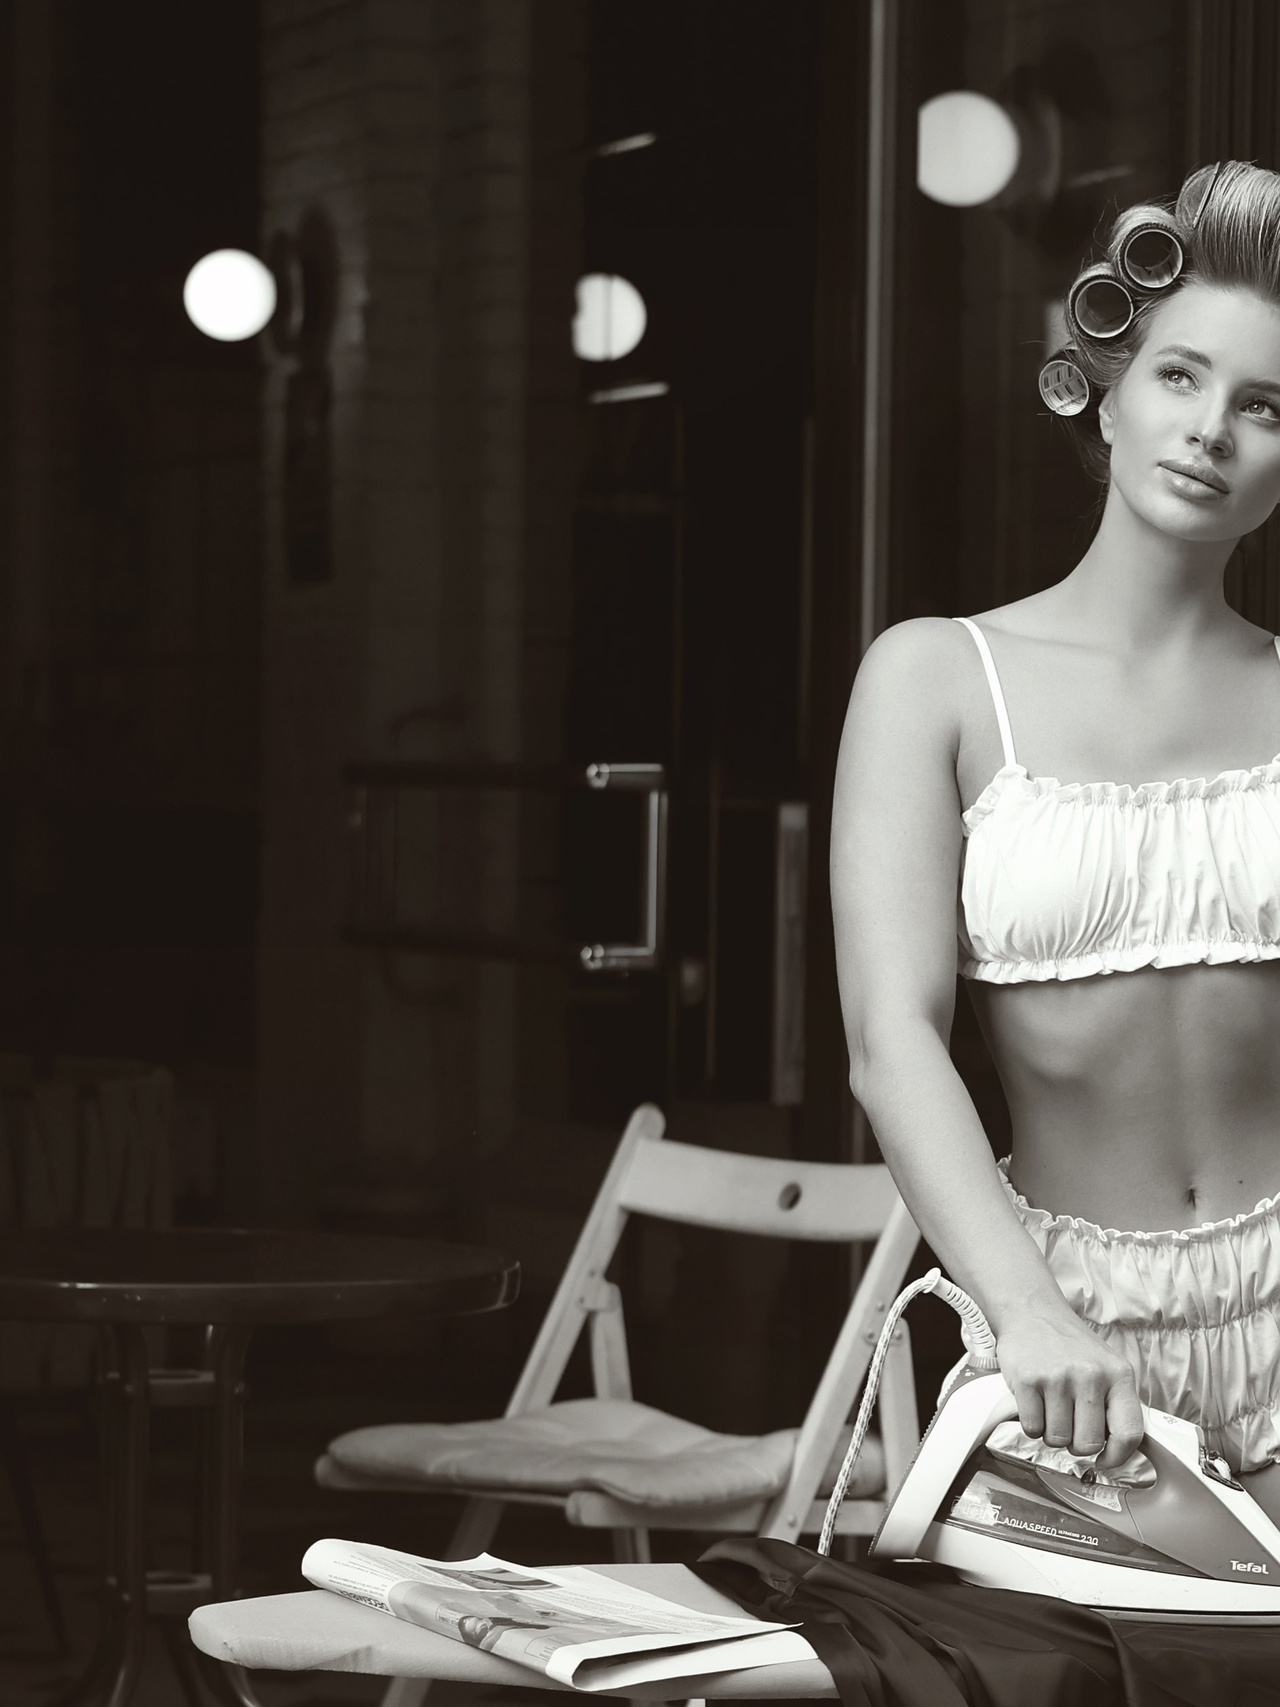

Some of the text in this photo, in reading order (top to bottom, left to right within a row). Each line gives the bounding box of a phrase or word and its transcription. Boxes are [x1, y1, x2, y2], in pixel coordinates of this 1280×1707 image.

[1003, 1516, 1057, 1536] AQUASPEED
[1080, 1534, 1099, 1546] 230
[1230, 1560, 1269, 1575] Tefal
